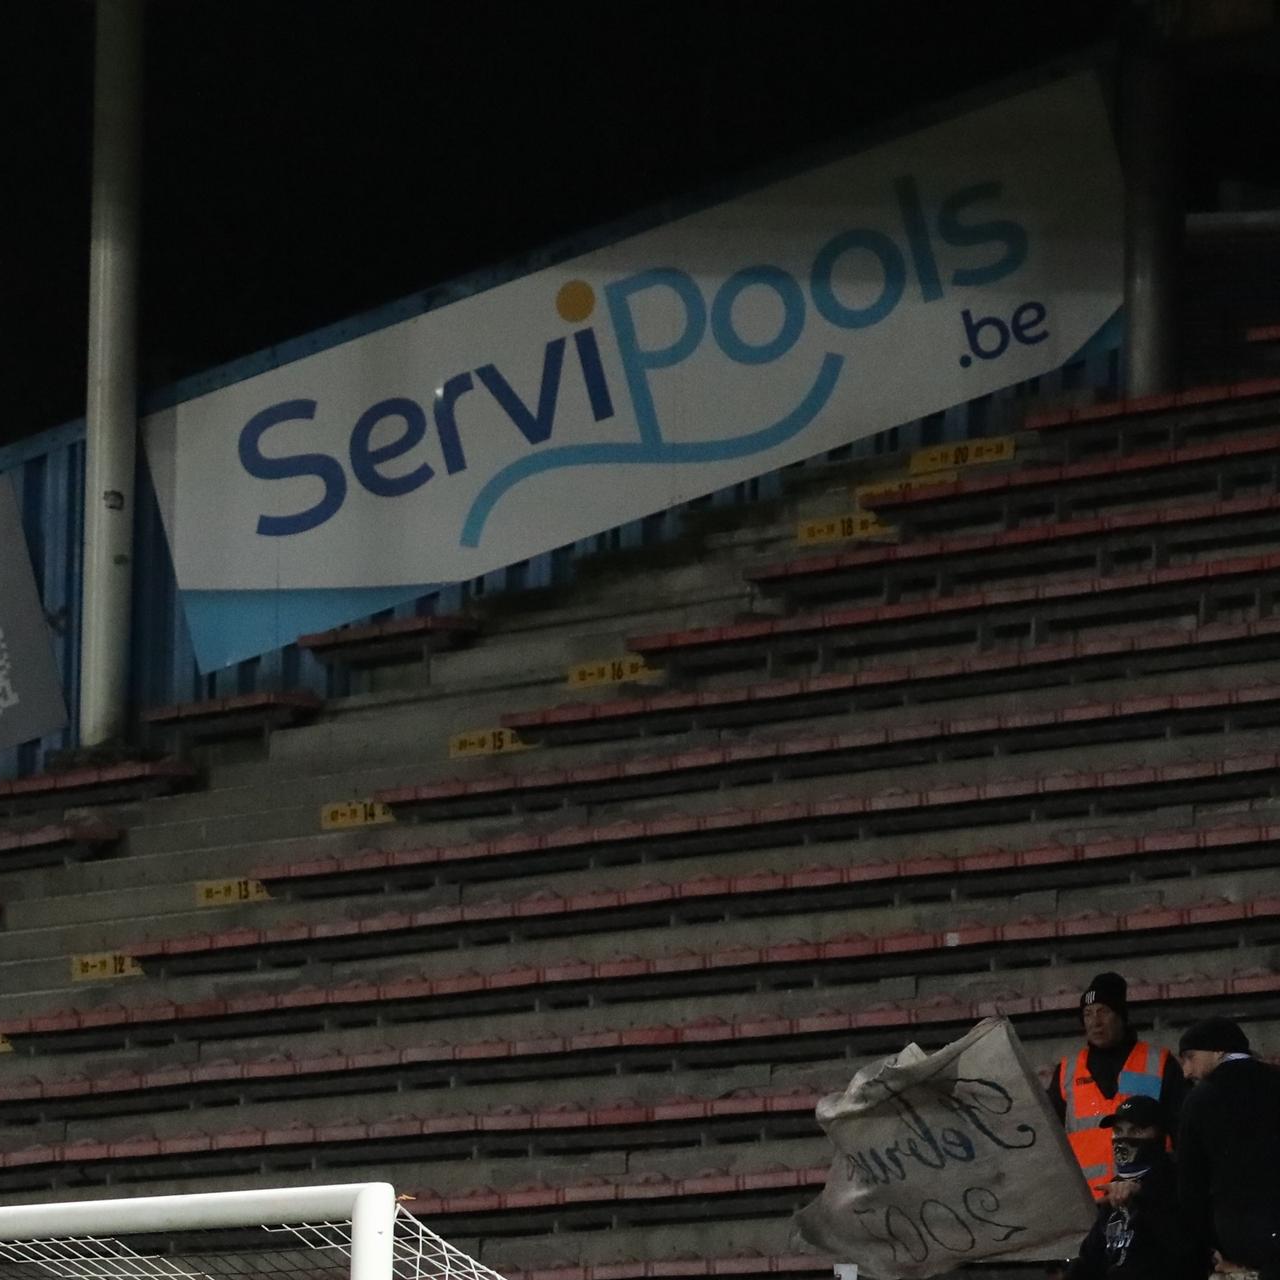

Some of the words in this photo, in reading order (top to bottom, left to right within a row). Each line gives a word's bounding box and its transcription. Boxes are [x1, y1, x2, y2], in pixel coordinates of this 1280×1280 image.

[957, 298, 1050, 370] .be
[611, 662, 624, 681] 16
[492, 731, 504, 751] 15
